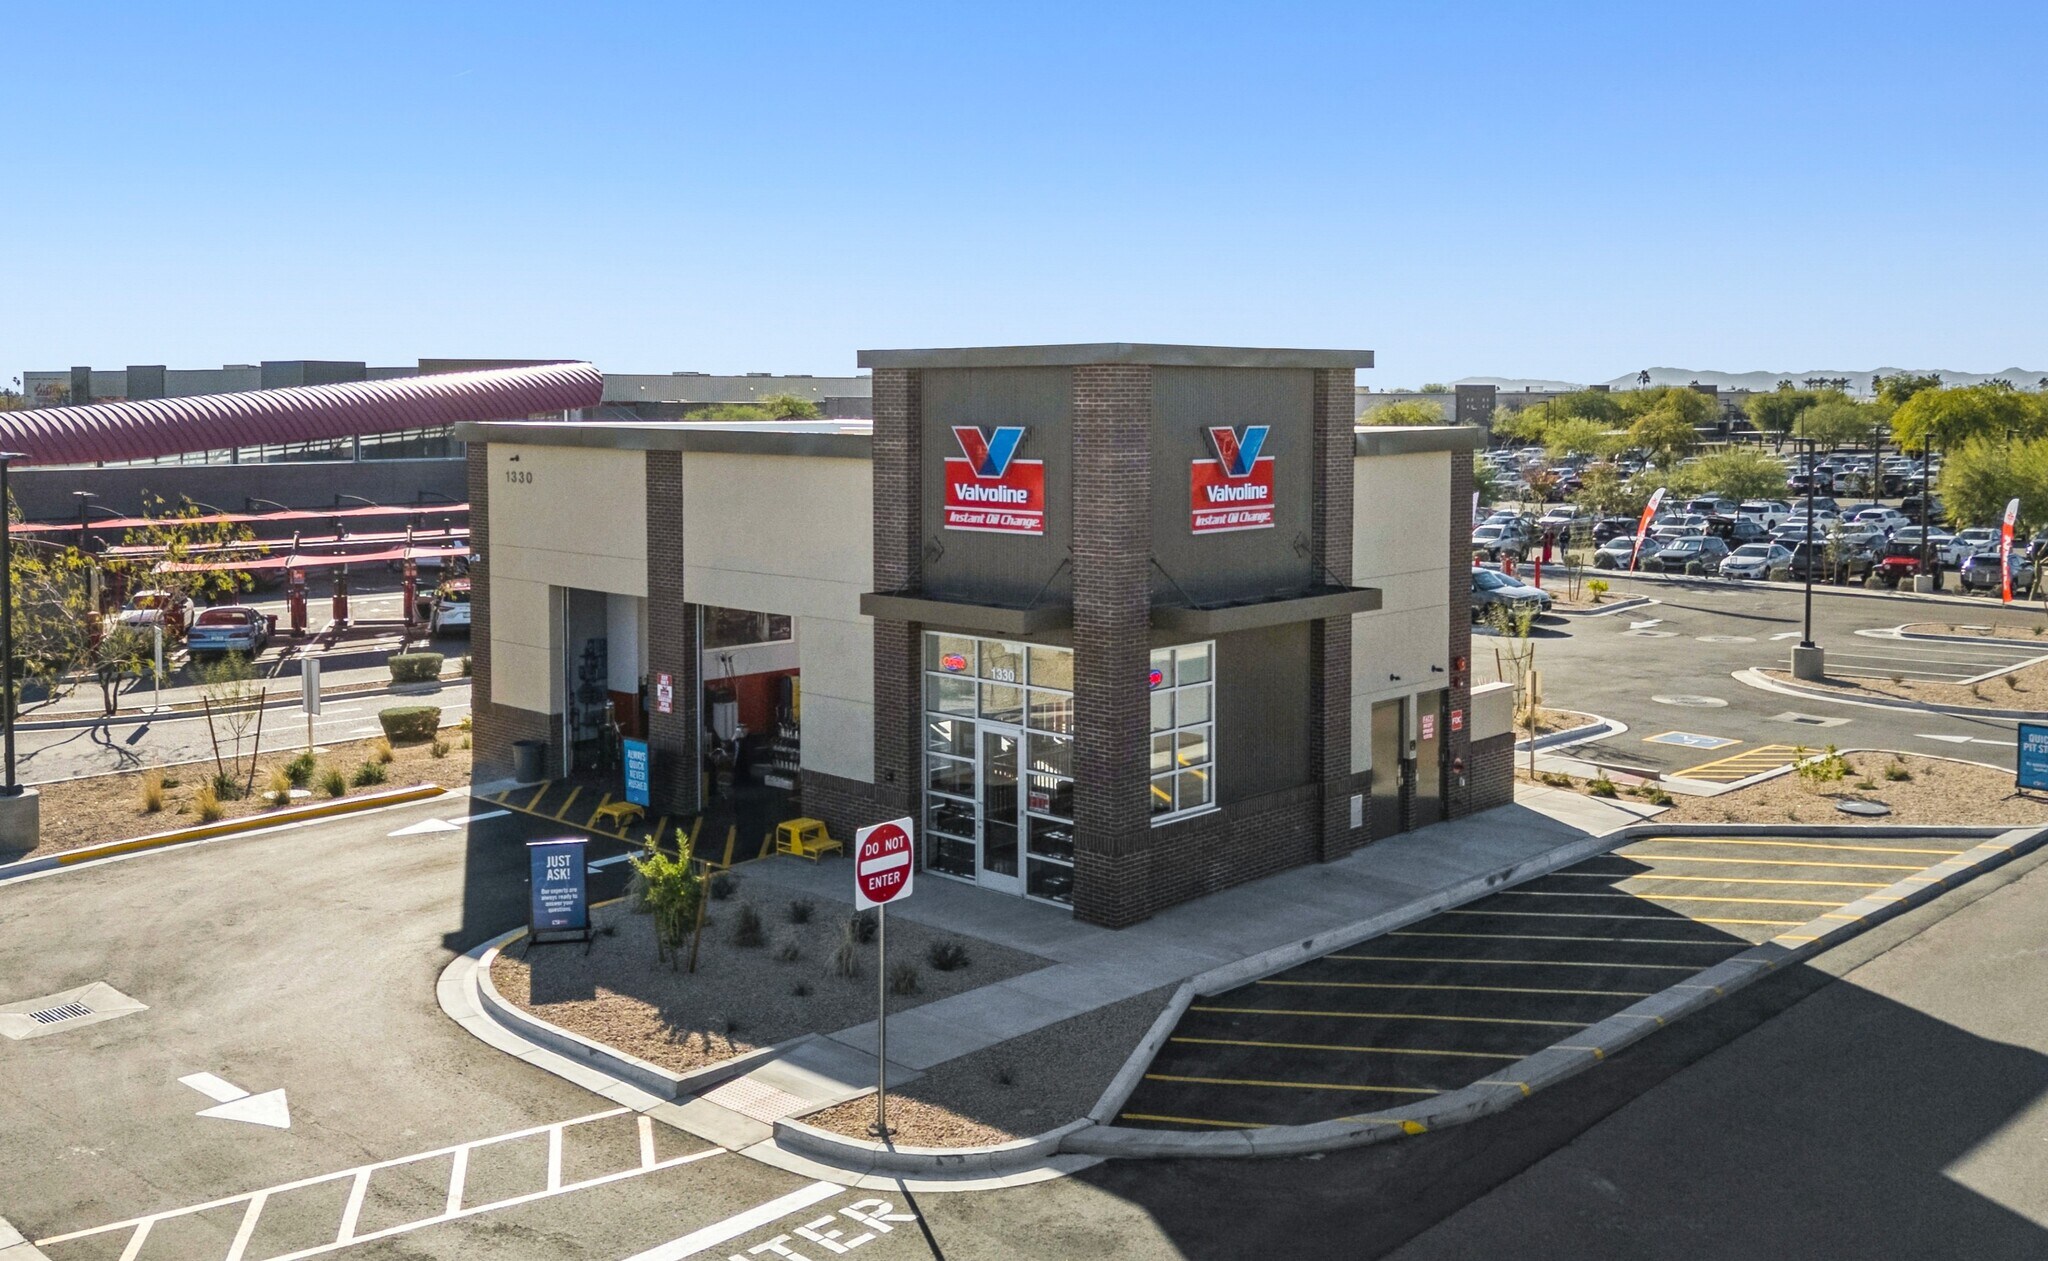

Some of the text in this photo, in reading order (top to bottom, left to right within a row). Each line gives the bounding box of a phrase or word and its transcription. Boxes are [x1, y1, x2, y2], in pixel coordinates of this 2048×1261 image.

[505, 470, 533, 484] 1330
[954, 483, 1028, 503] Valvoline
[1206, 483, 1268, 502] Valvoline
[950, 512, 985, 524] Instant
[986, 513, 1001, 524] Oil
[1195, 514, 1227, 526] Instant
[1227, 512, 1240, 523] Oil
[991, 667, 1015, 681] 1330
[2023, 742, 2037, 752] PIT
[629, 769, 645, 780] NEVER
[865, 835, 905, 857] DO NOT
[546, 855, 571, 868] JUST
[546, 868, 571, 881] ASK!
[869, 871, 900, 890] ENTER
[728, 1198, 919, 1261] TER
